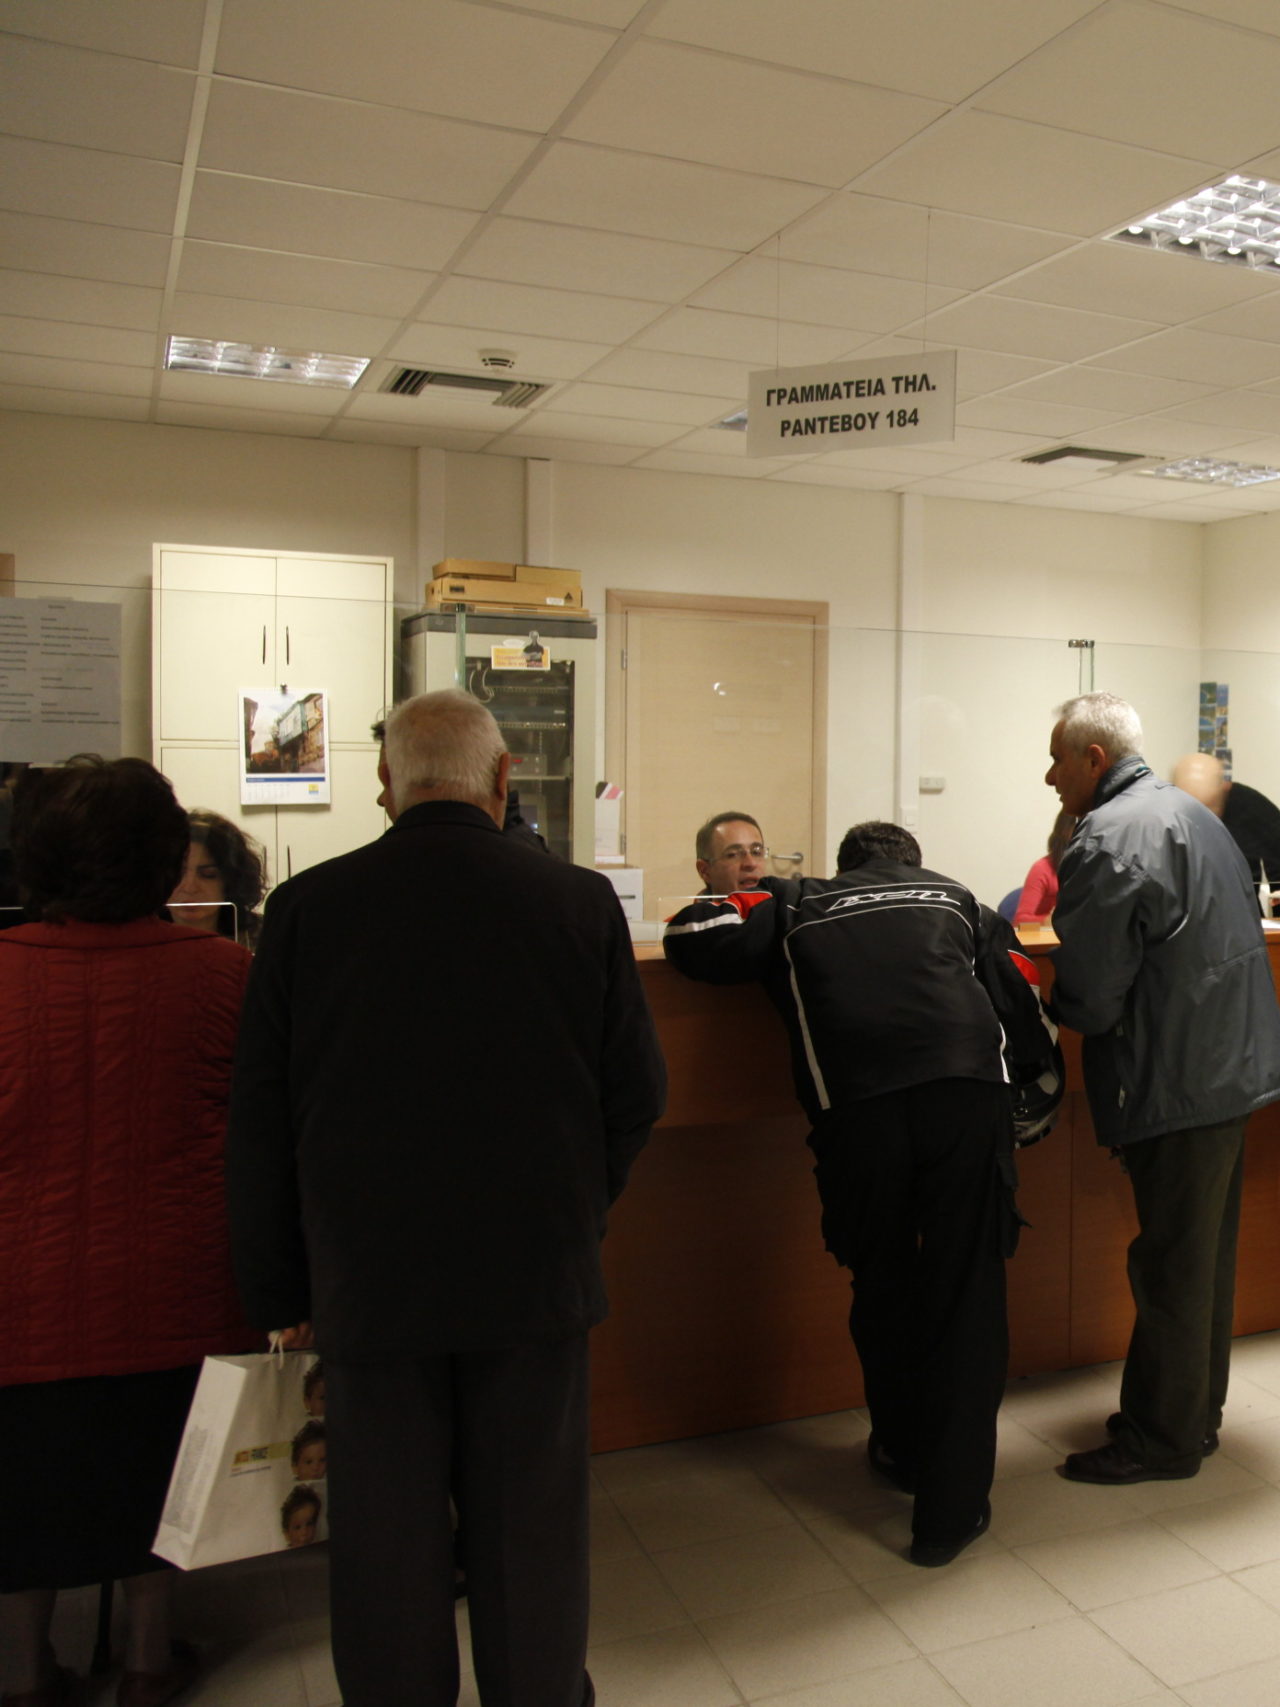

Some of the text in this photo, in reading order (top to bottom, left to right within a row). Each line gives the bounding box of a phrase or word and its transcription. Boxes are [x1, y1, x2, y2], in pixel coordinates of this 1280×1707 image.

[766, 373, 937, 407] ΓΡΑΜΜΑΤΕΙΑ ΤΗΛ.
[780, 407, 920, 438] ΡΑΝΤΕΒΟΥ 184
